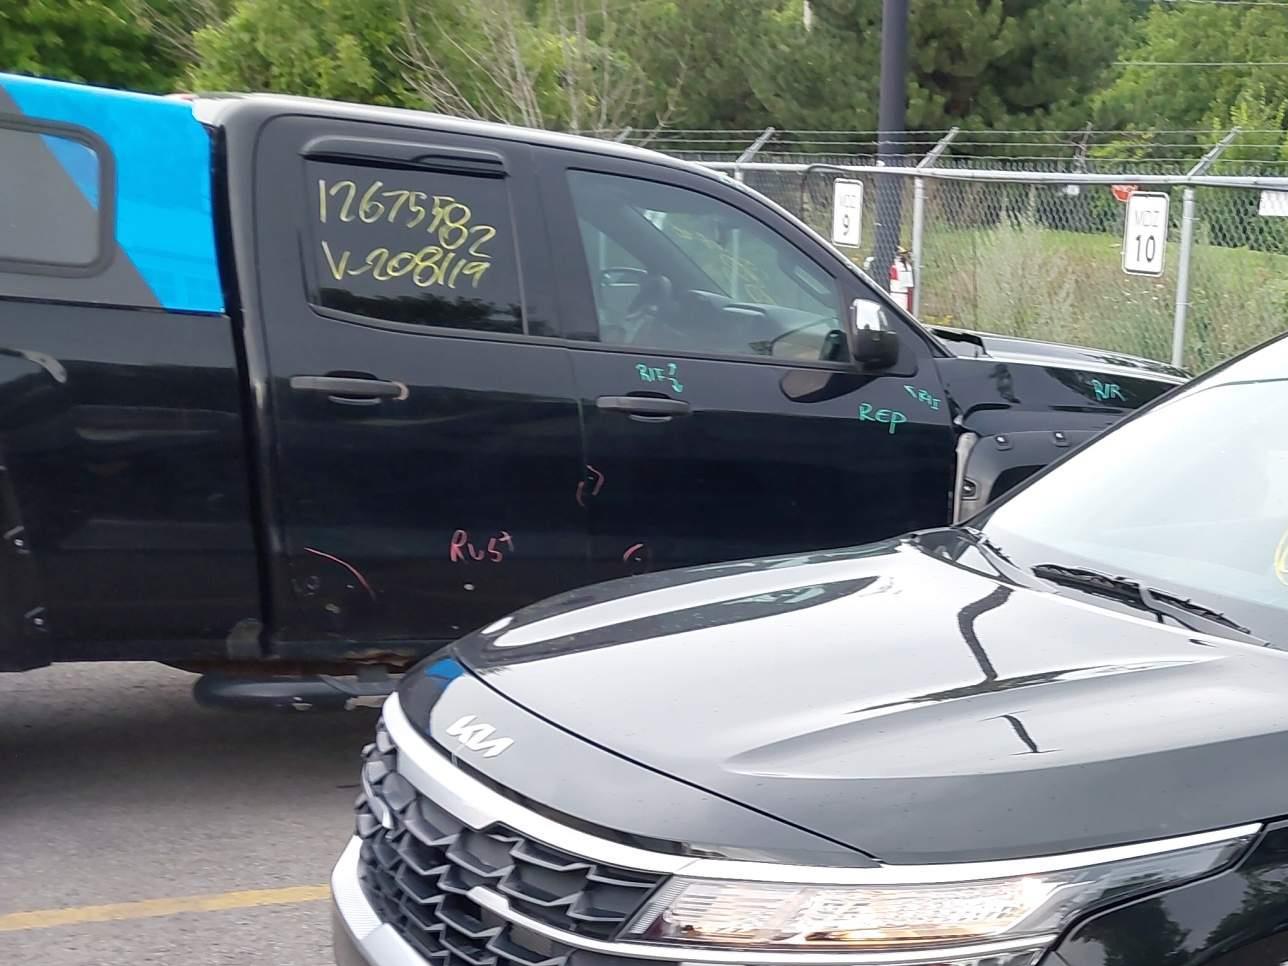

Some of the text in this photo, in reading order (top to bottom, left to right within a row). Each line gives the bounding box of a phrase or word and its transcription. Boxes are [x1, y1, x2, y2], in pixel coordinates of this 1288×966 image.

[317, 178, 498, 259] 12675582
[842, 213, 850, 236] 9
[1136, 234, 1156, 263] 10
[859, 402, 907, 434] REP
